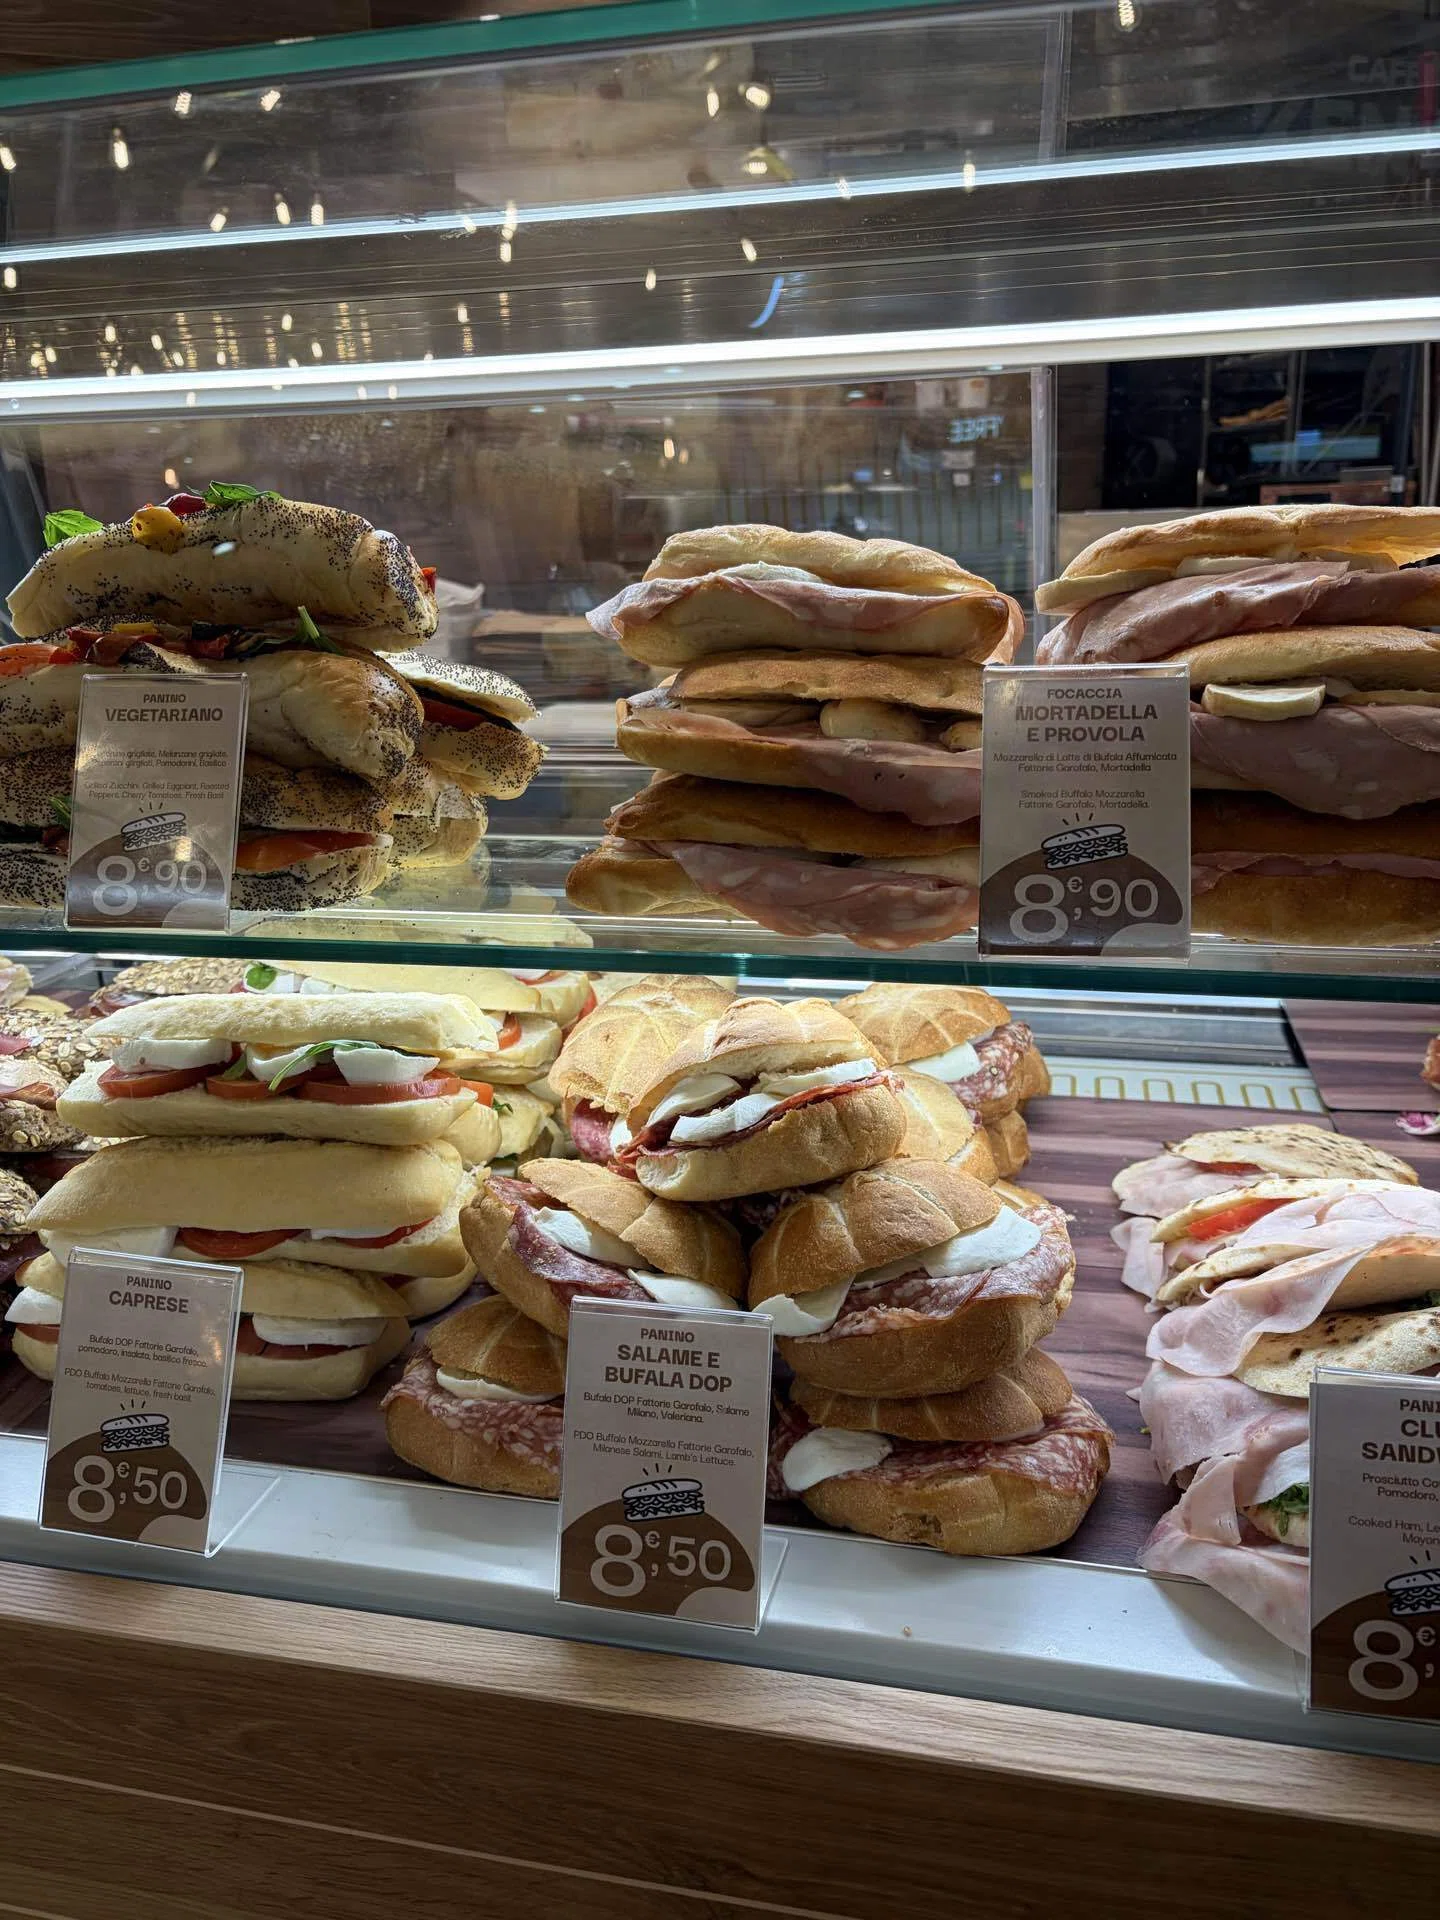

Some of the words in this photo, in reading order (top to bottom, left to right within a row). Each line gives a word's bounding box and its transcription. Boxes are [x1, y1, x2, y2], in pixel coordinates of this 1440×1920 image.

[143, 694, 186, 703] PANINO
[1047, 688, 1122, 699] FOCACCIA
[106, 708, 223, 722] VEGETARIANO
[1015, 704, 1158, 721] MORTADELLA
[1027, 726, 1040, 742] E
[1045, 726, 1145, 742] PROVOLA
[993, 752, 1043, 761] Mozzarella
[1046, 752, 1055, 761] di
[1057, 752, 1081, 761] Latte
[1083, 752, 1091, 761] di
[1094, 752, 1123, 761] Bufala
[1126, 752, 1177, 761] Affumicata
[1021, 789, 1058, 798] Smoked
[1061, 789, 1093, 798] Buffalo
[1095, 789, 1145, 798] Mozzarella
[126, 1275, 172, 1290] PANINO
[109, 1290, 189, 1314] CAPRESE
[90, 1335, 114, 1345] Bufala
[115, 1337, 133, 1347] DOP
[640, 1328, 695, 1343] PANINO
[78, 1345, 120, 1357] pomodoro,
[617, 1344, 703, 1368] SALAME
[708, 1352, 720, 1369] E
[65, 1367, 82, 1377] PDO
[84, 1370, 110, 1381] Buffalo
[111, 1374, 151, 1386] Mozzarella
[605, 1366, 684, 1389] BUFALA
[689, 1373, 732, 1393] DOP
[584, 1391, 612, 1403] Bufala
[613, 1394, 635, 1405] DOP
[637, 1396, 671, 1408] Fattorie
[673, 1400, 714, 1414] Garofalo,
[716, 1404, 750, 1416] Salame
[627, 1407, 659, 1419] Milano,
[573, 1430, 594, 1440] PDO
[596, 1432, 626, 1443] Buffalo
[628, 1435, 676, 1449] Mozzarella
[678, 1440, 712, 1452] Fattorie
[714, 1444, 754, 1458] Garofalo,
[593, 1443, 631, 1455] Milanese
[1361, 1441, 1440, 1465] SAND
[1362, 1472, 1419, 1487] Prosciutto
[1421, 1477, 1440, 1489] Co
[1348, 1515, 1392, 1529] Cooked
[1395, 1519, 1423, 1532] Ham,
